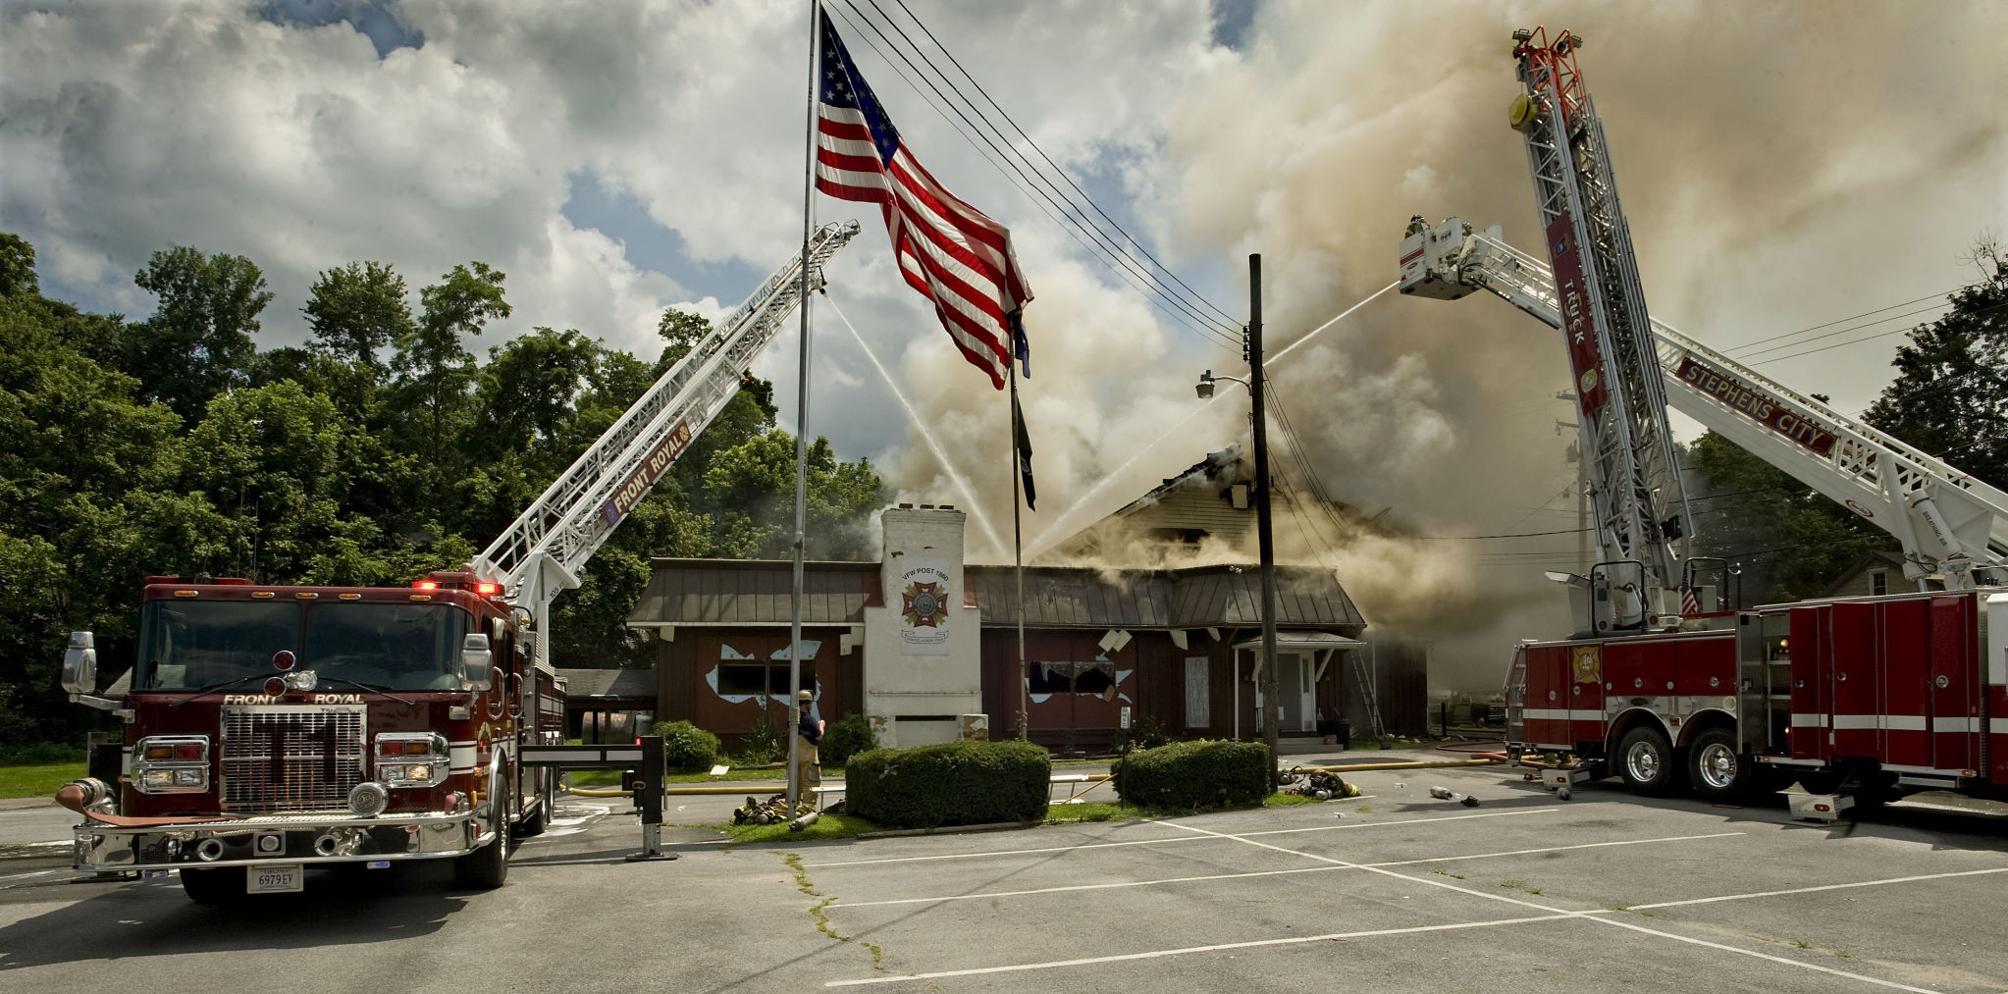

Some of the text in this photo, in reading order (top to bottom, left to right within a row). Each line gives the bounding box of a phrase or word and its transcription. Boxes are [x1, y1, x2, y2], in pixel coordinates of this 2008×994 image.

[1564, 278, 1585, 345] TRUCK
[1686, 366, 1824, 446] STEPHENS CITY
[613, 434, 682, 513] FRONT ROYAL
[902, 569, 916, 580] VFW
[223, 693, 365, 705] FRONT ROYAL
[252, 720, 337, 784] T1
